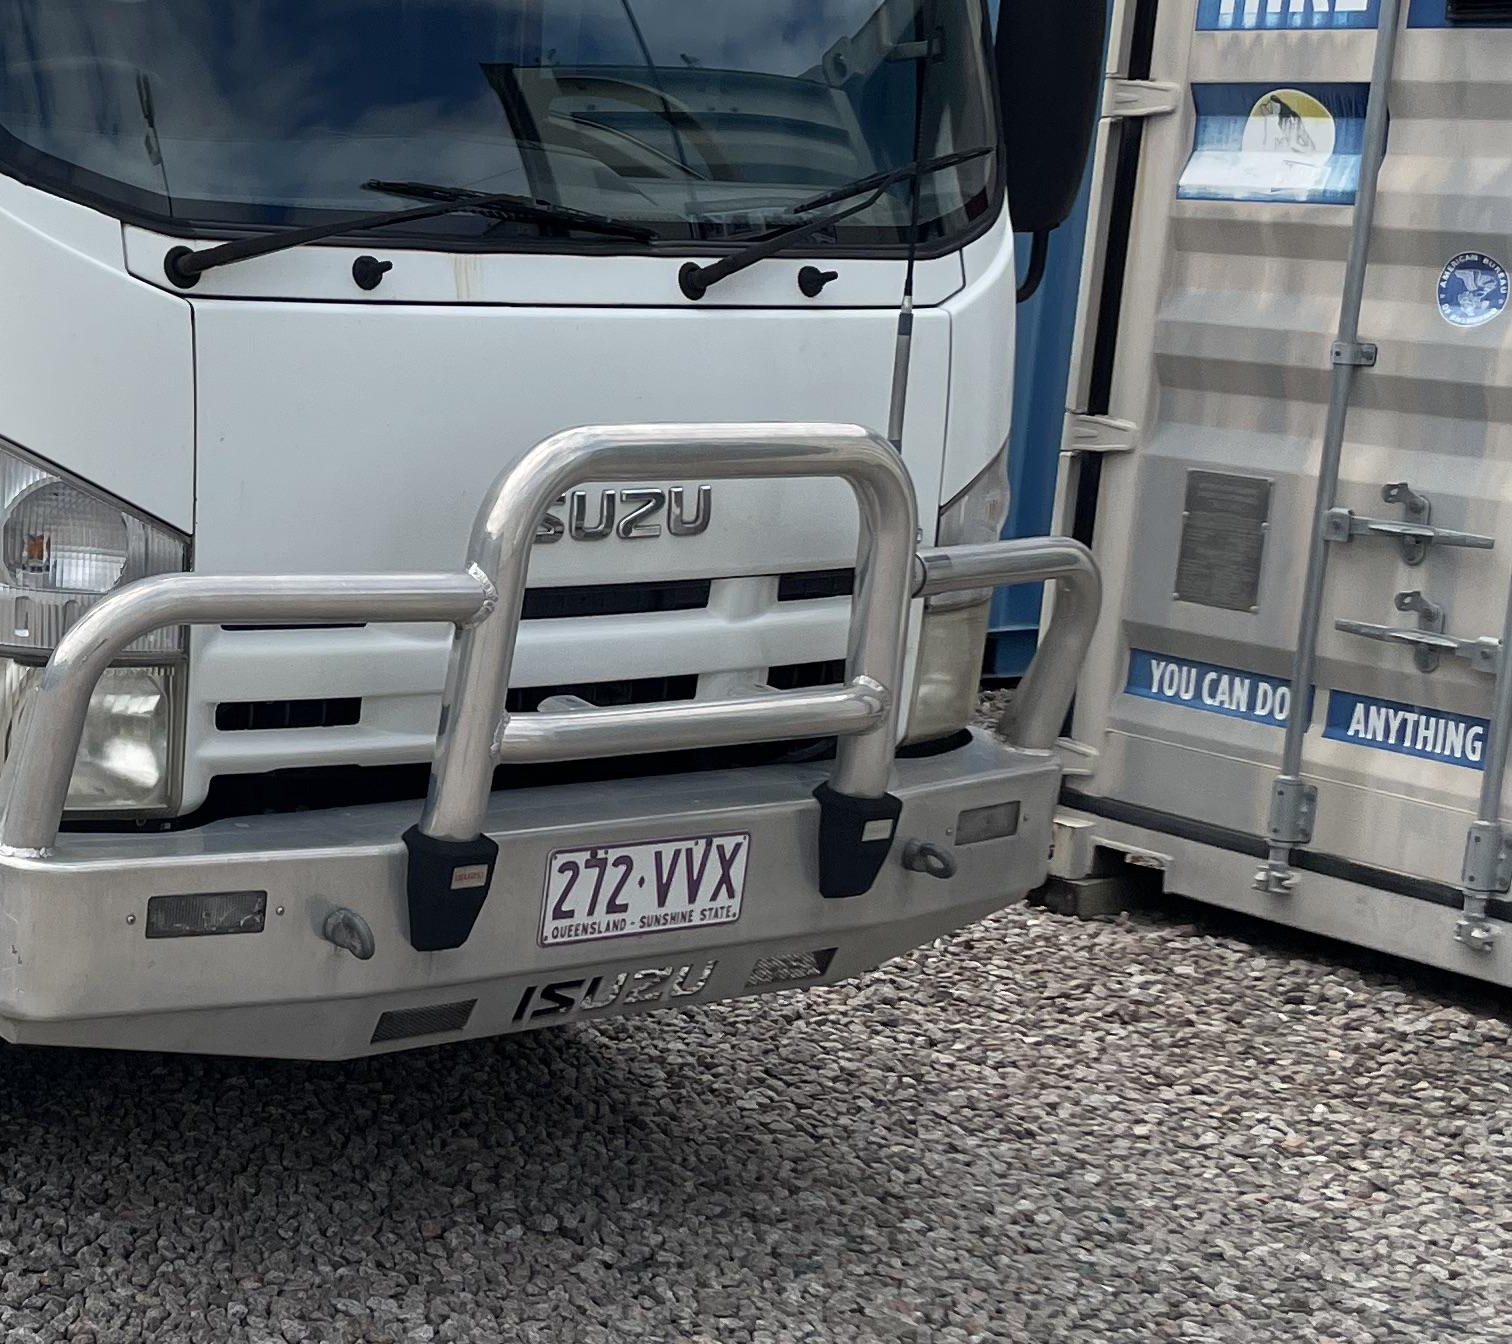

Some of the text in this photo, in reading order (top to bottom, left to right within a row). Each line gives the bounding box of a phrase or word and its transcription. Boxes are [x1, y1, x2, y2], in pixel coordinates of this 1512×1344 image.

[1439, 254, 1479, 289] AMERICAN
[1482, 257, 1508, 294] BUREAU
[532, 483, 713, 545] SUZU
[1149, 659, 1292, 721] YOU CAN DO
[1346, 701, 1485, 762] ANYTHING
[550, 917, 627, 940] QUEENSLAND
[638, 909, 694, 930] SUNSHINE
[699, 904, 733, 922] STATE
[511, 959, 719, 1024] ISUZU
